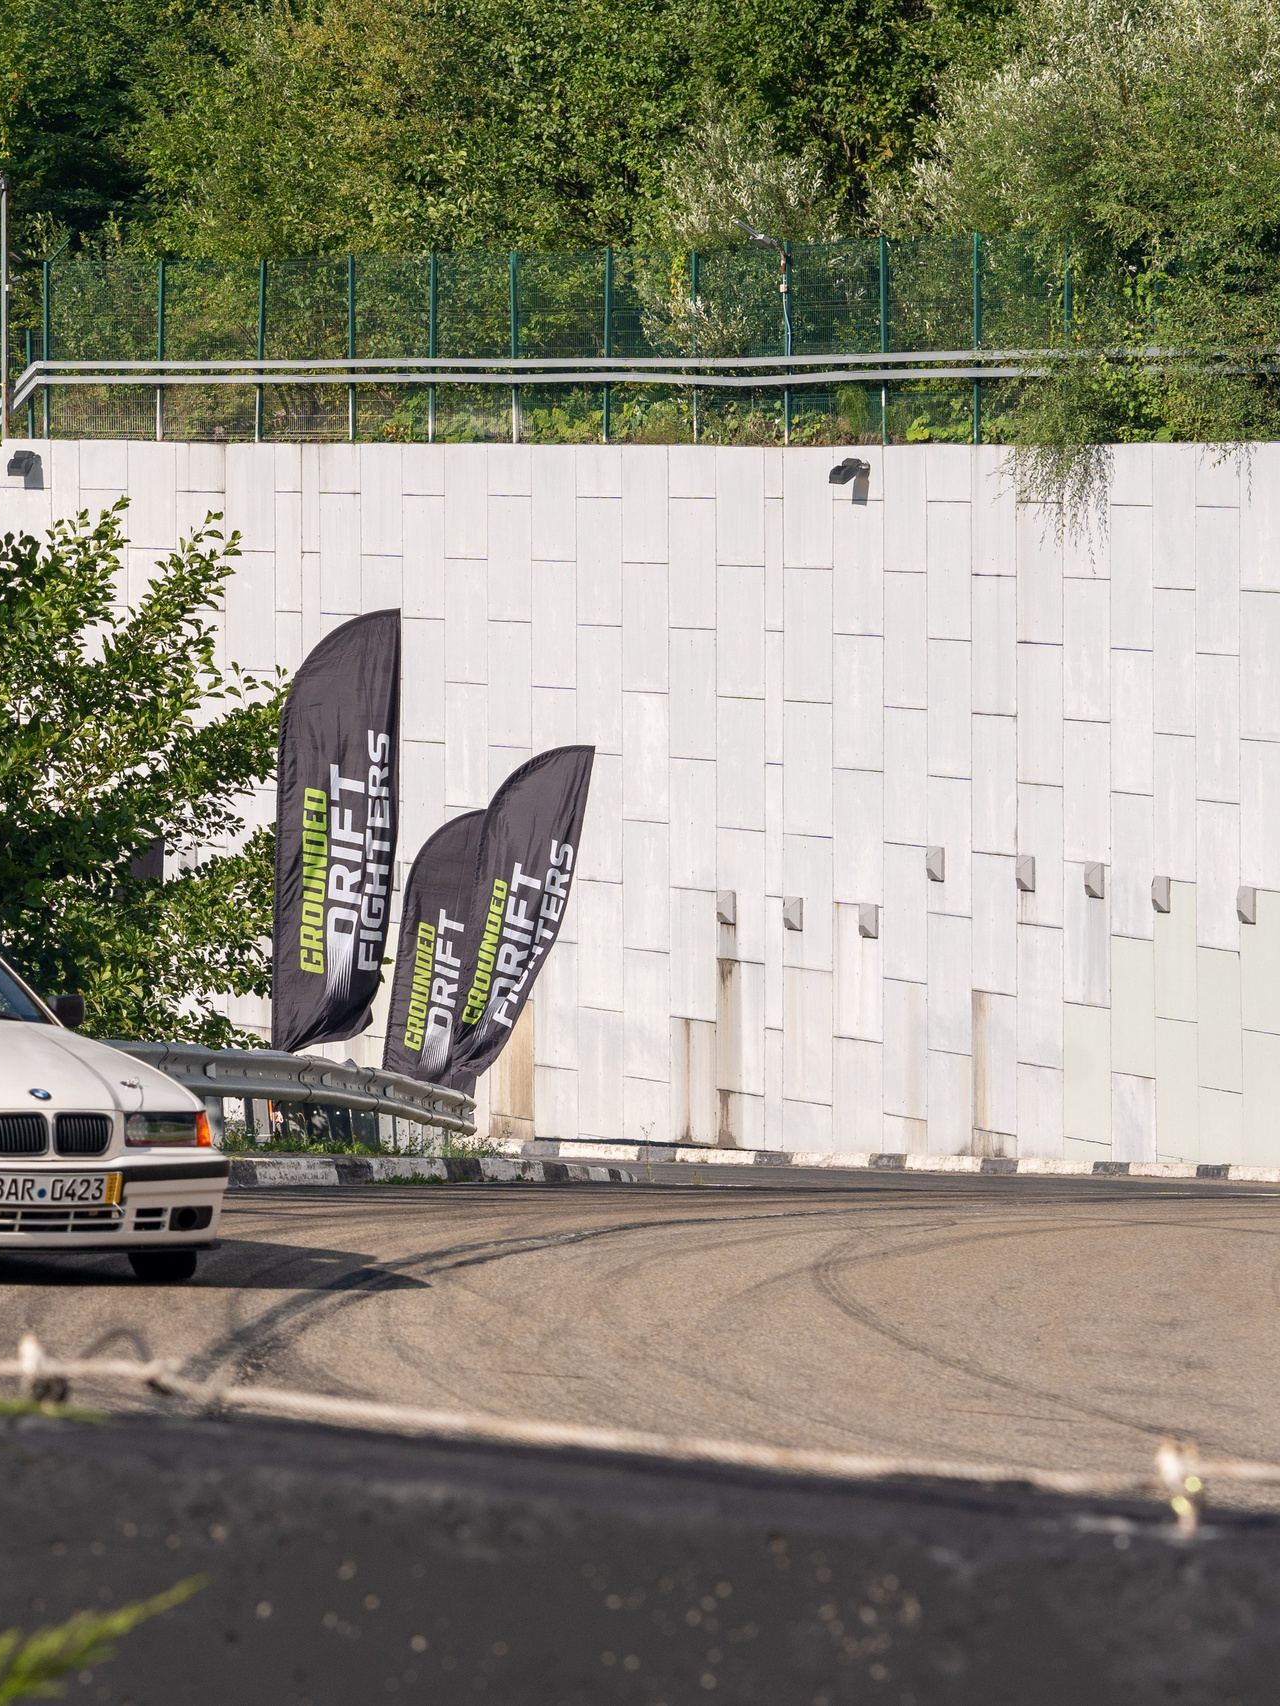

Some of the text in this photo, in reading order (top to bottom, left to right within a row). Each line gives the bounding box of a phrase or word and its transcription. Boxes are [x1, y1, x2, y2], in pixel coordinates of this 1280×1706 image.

[300, 787, 328, 975] GROUNDED
[326, 763, 365, 949] DRIFT
[357, 729, 391, 971] FIGHTERS
[404, 921, 436, 1051] GROUNDED
[426, 908, 465, 1039] DRIFT
[462, 878, 508, 1025] GROUNDED
[488, 862, 542, 1010] DRIFT
[50, 1178, 105, 1201] 0423
